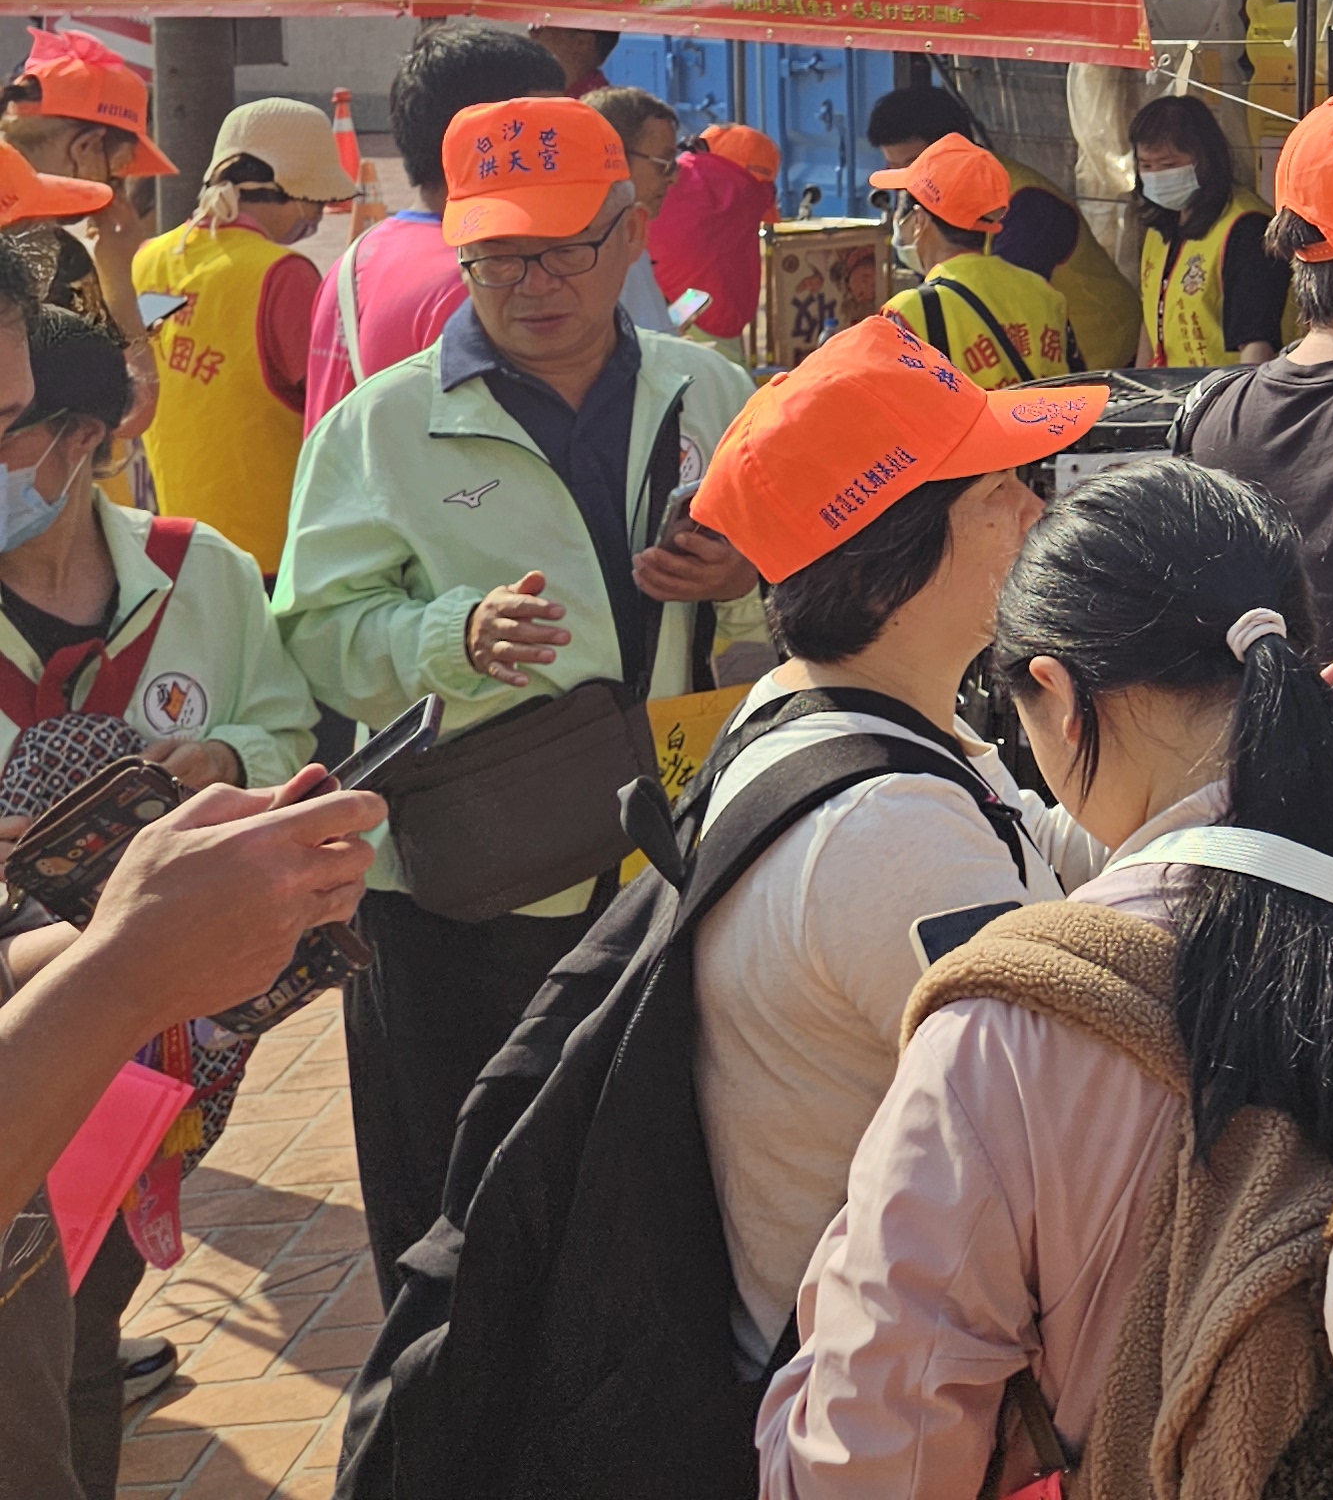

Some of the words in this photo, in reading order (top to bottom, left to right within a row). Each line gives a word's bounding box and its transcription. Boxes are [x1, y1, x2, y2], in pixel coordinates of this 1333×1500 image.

[476, 119, 559, 155] 白沙屯
[479, 149, 559, 180] 拱天宮
